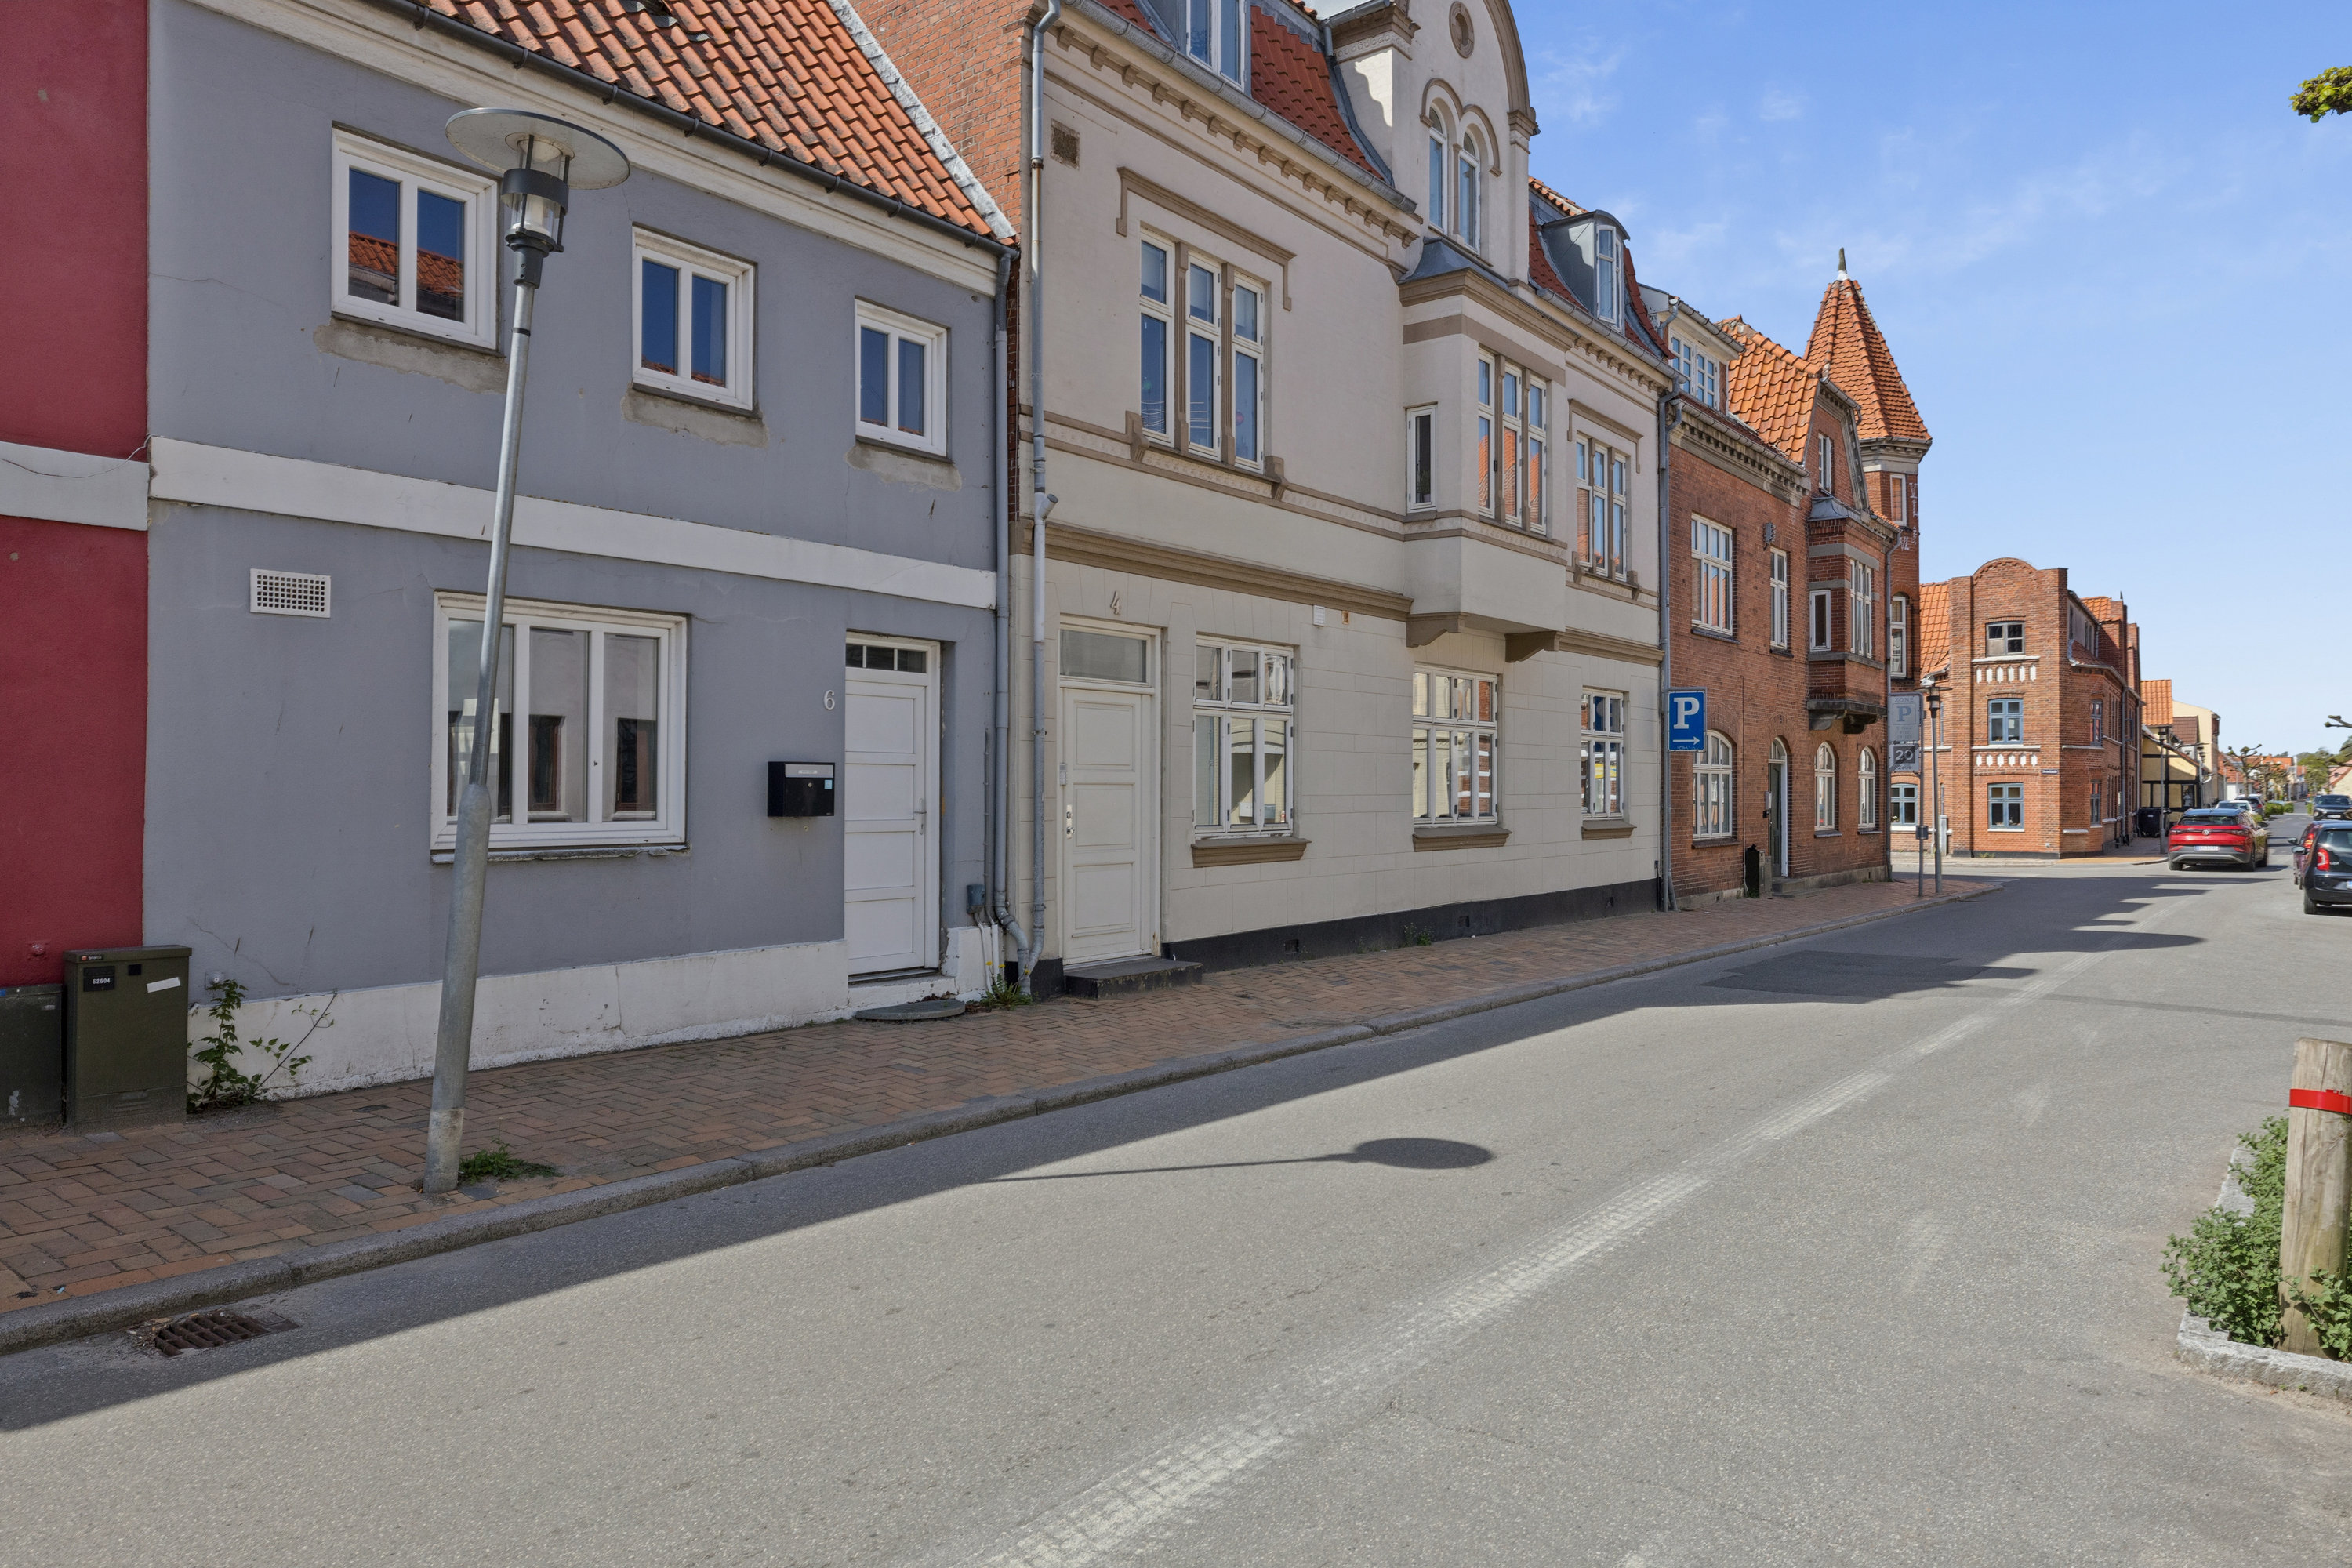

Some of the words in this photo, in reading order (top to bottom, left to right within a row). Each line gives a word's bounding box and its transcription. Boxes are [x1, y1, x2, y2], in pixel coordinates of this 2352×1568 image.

[1109, 590, 1121, 615] 4
[824, 690, 835, 710] 6
[1673, 697, 1700, 729] P
[1897, 706, 1912, 721] P
[1895, 750, 1913, 760] 20
